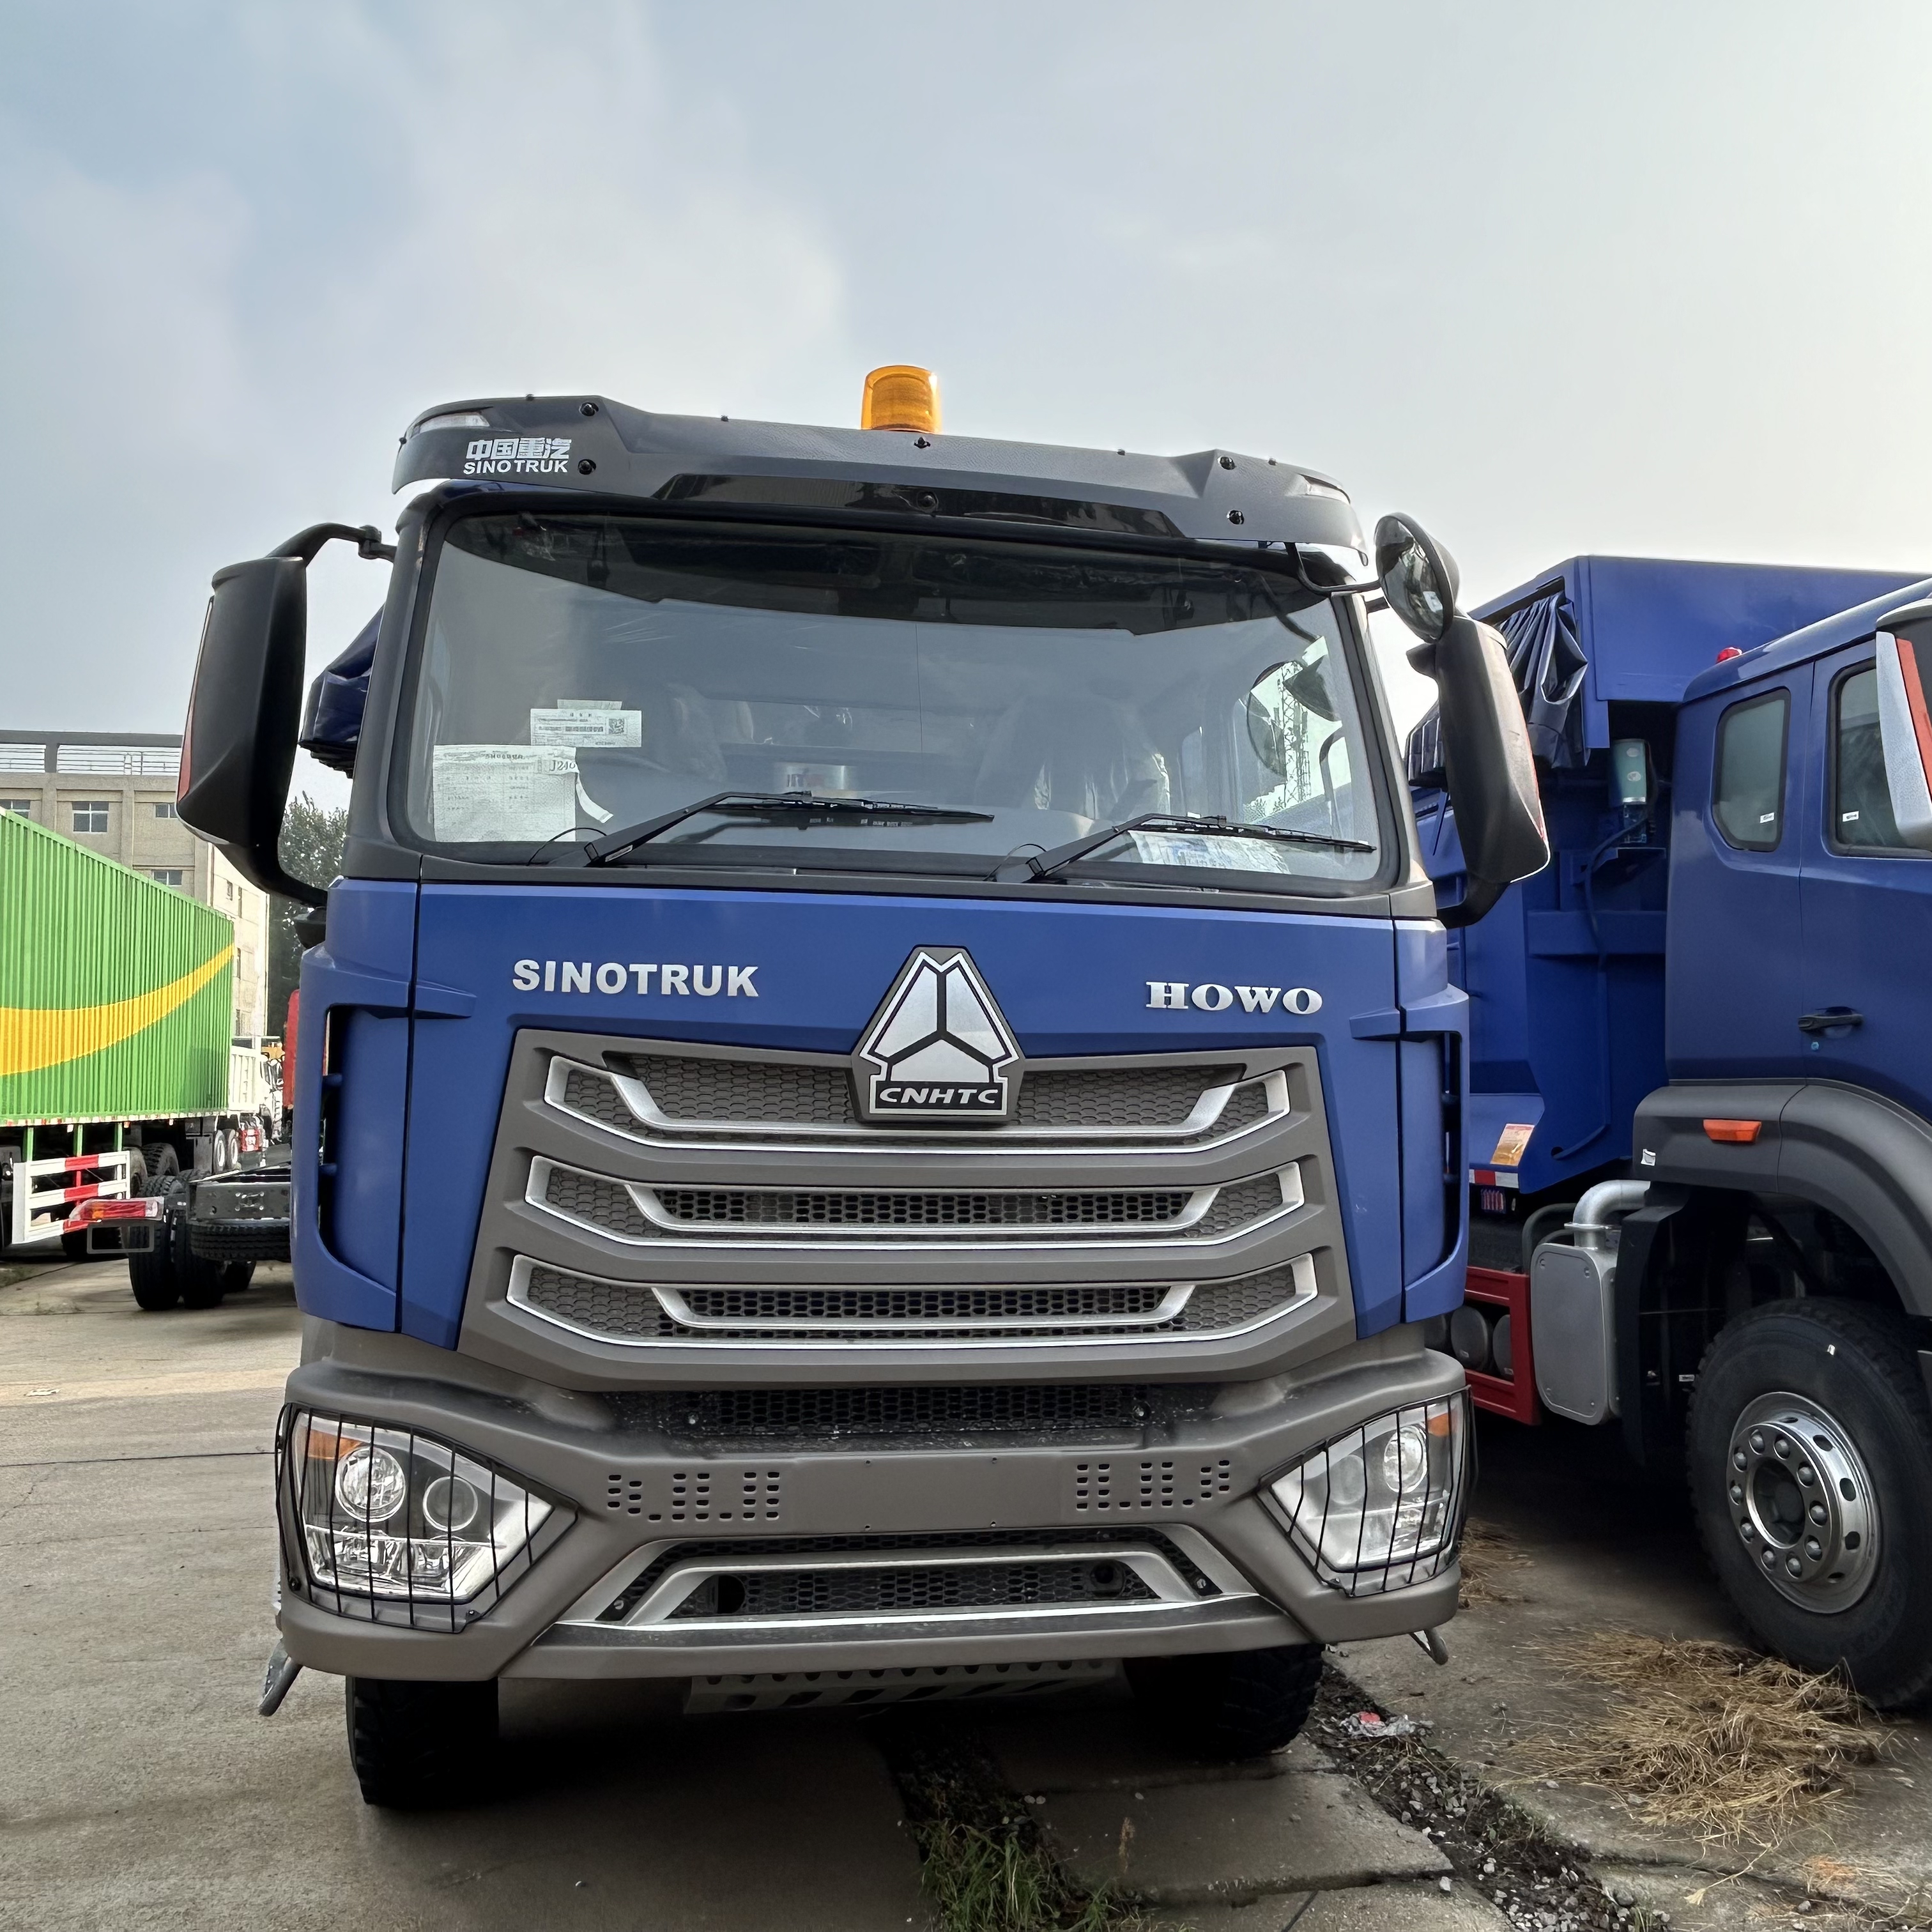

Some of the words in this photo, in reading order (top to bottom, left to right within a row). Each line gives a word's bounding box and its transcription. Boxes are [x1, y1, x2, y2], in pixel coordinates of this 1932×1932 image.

[466, 438, 572, 460] 中国重汽
[463, 460, 568, 475] SINOTRUK
[512, 960, 759, 997] SINOTRUK
[1146, 981, 1322, 1015] HOWO
[880, 1088, 998, 1104] CNHTC
